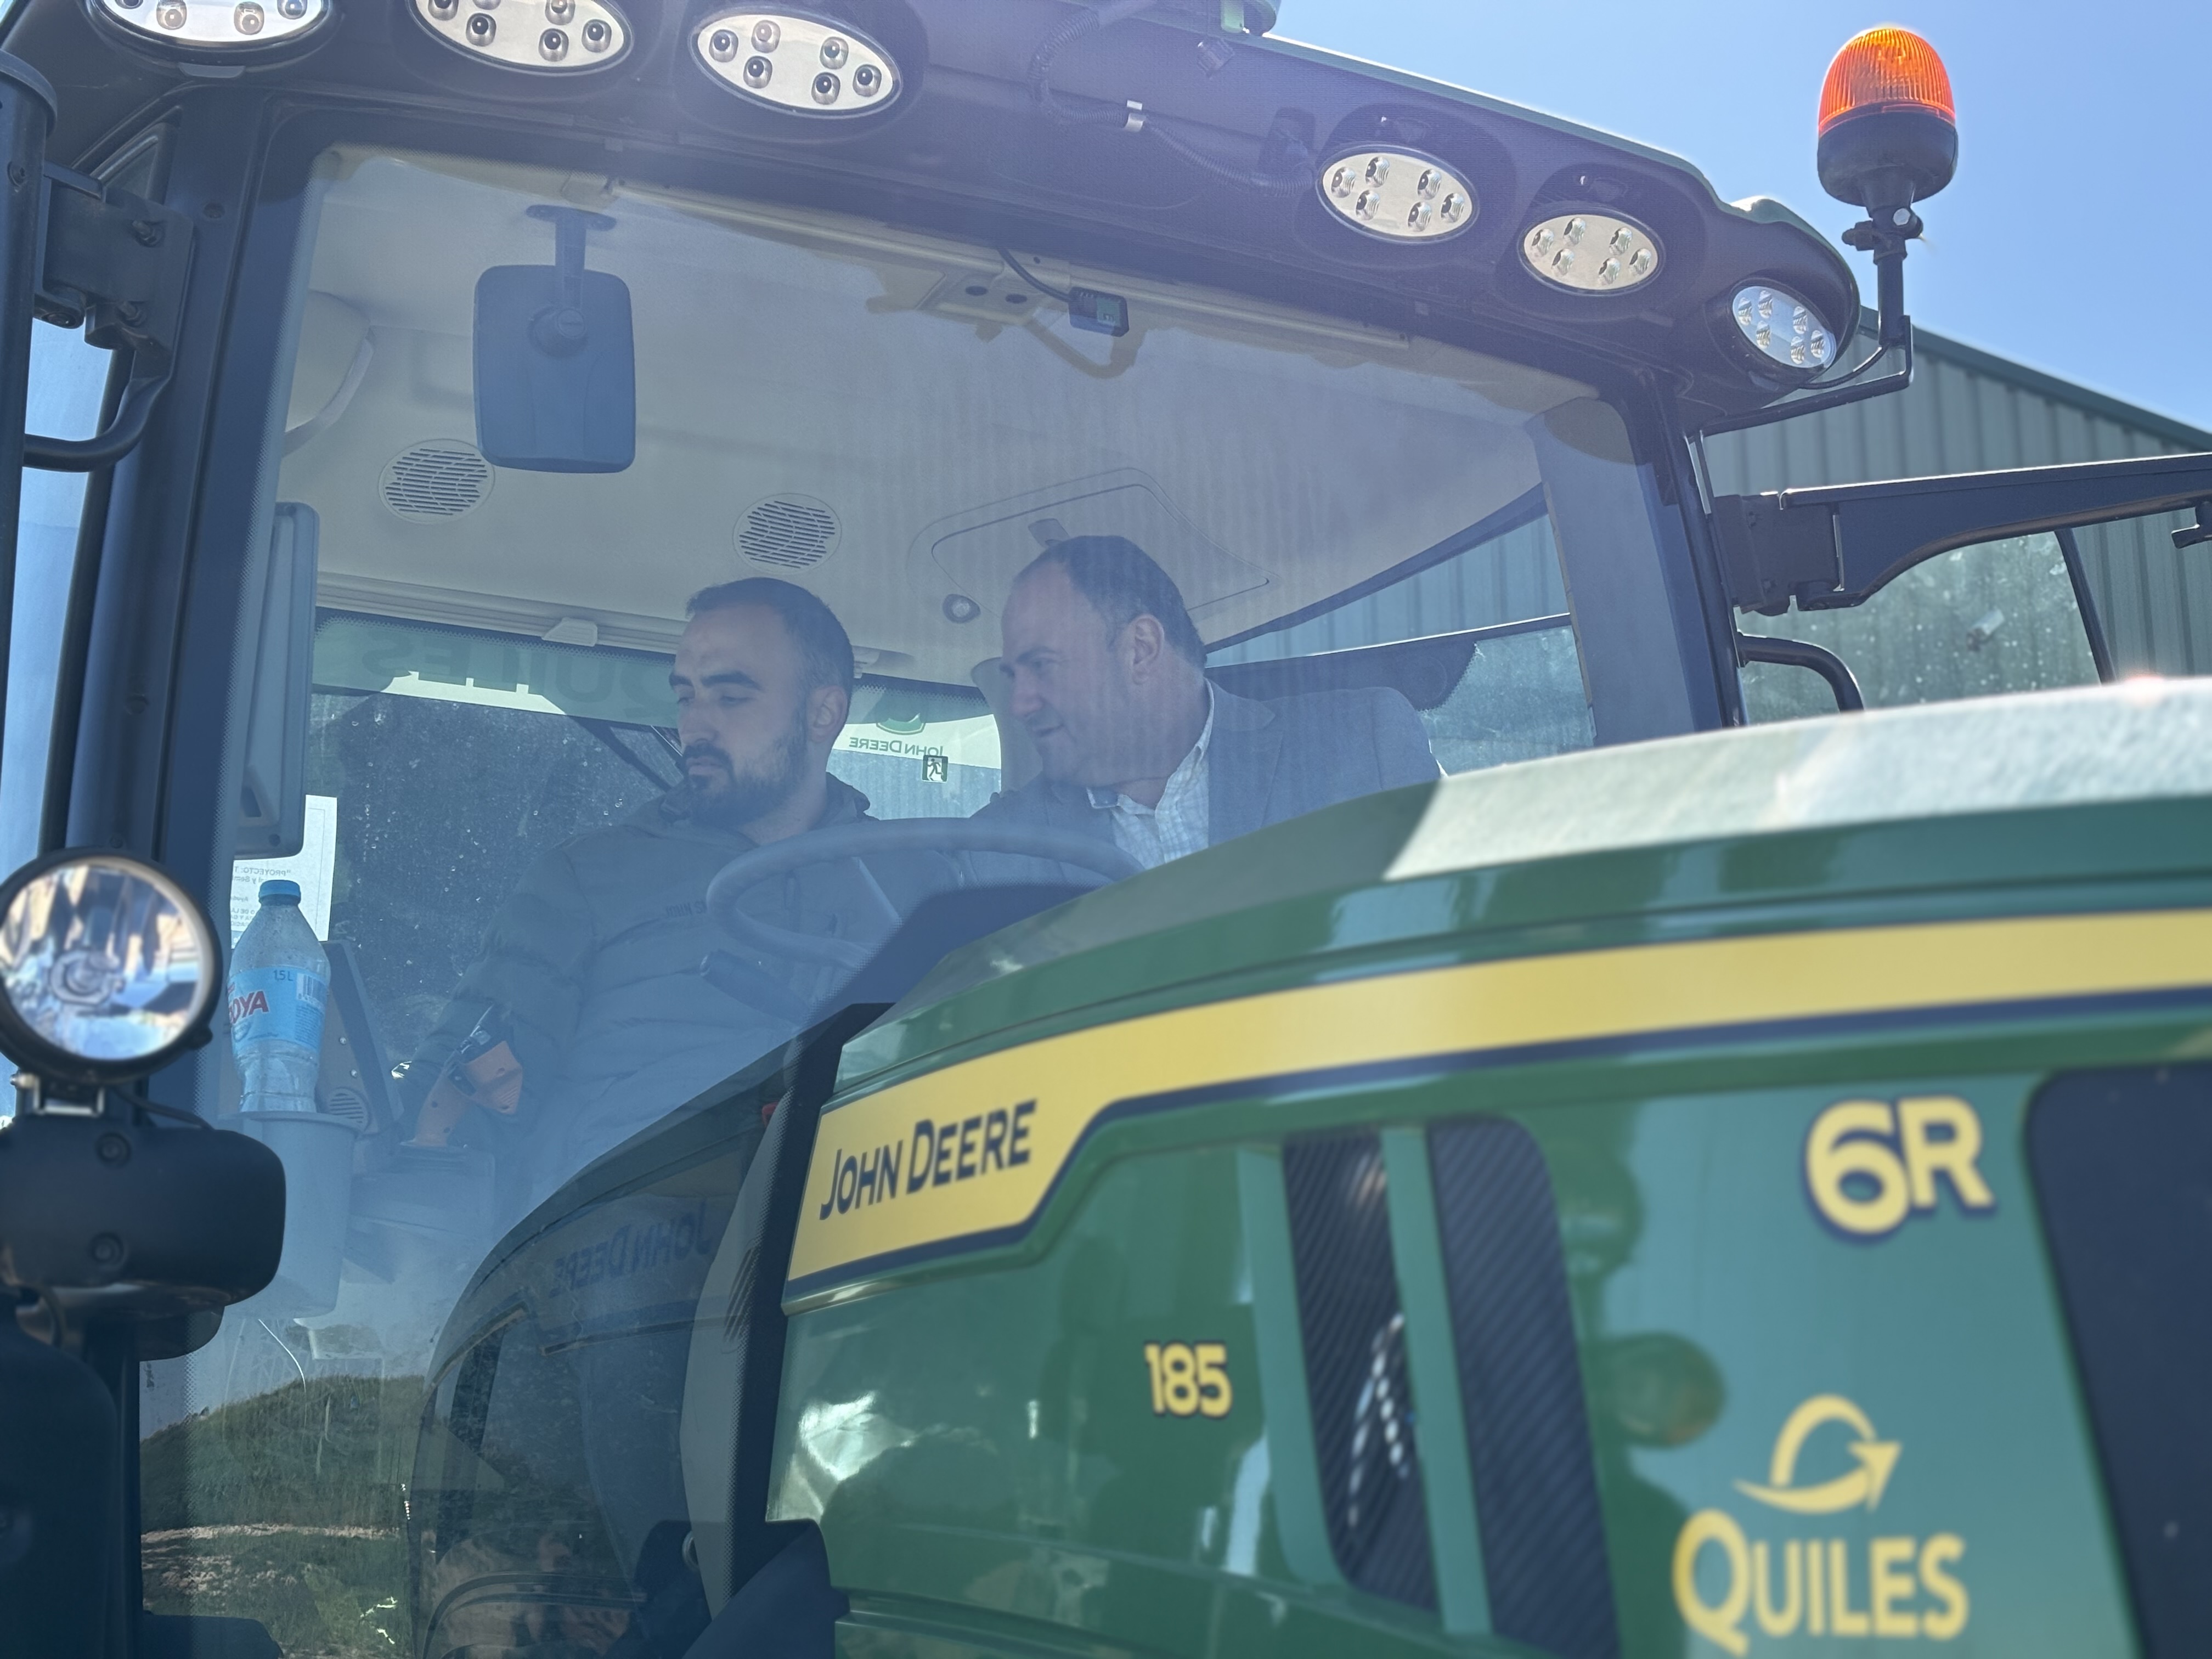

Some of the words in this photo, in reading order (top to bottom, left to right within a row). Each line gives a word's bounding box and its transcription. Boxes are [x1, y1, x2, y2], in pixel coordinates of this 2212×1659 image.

[287, 971, 294, 981] L
[820, 1139, 903, 1220] JOHN
[906, 1098, 1037, 1195] DEERE
[1805, 1095, 1995, 1235] 6R
[1144, 1342, 1232, 1418] 185
[1671, 1508, 1969, 1658] QUILES
